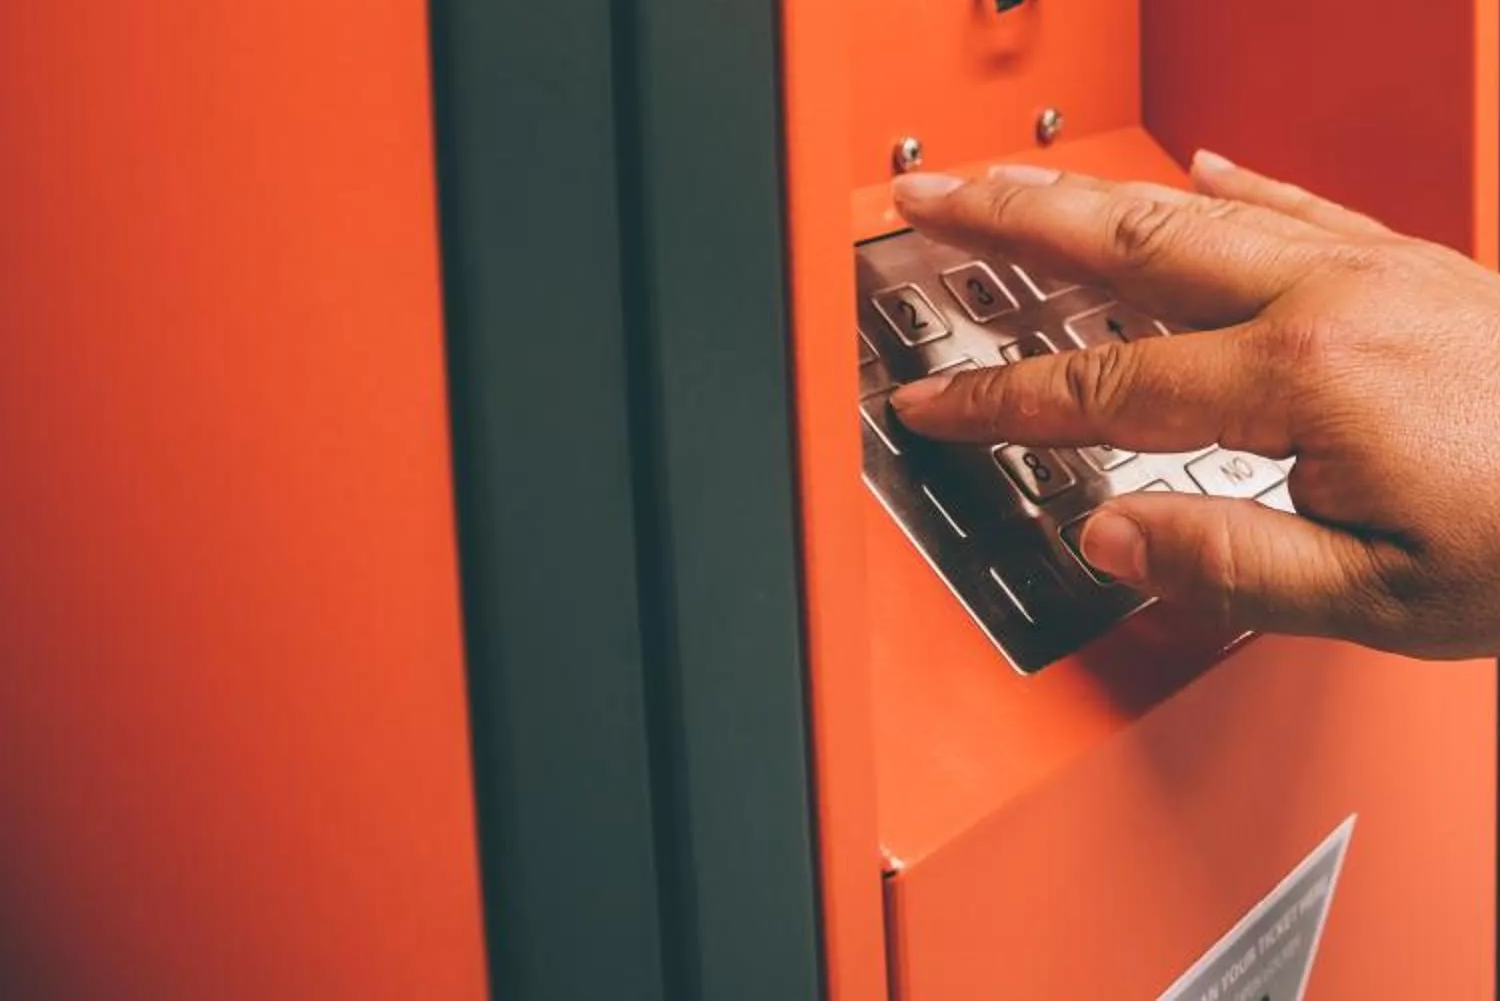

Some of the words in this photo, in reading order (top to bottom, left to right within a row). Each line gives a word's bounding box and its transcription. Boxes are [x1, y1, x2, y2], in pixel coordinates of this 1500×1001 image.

[966, 278, 995, 306] 3
[898, 300, 928, 330] 2
[1023, 452, 1052, 483] 8
[1219, 456, 1254, 487] NO
